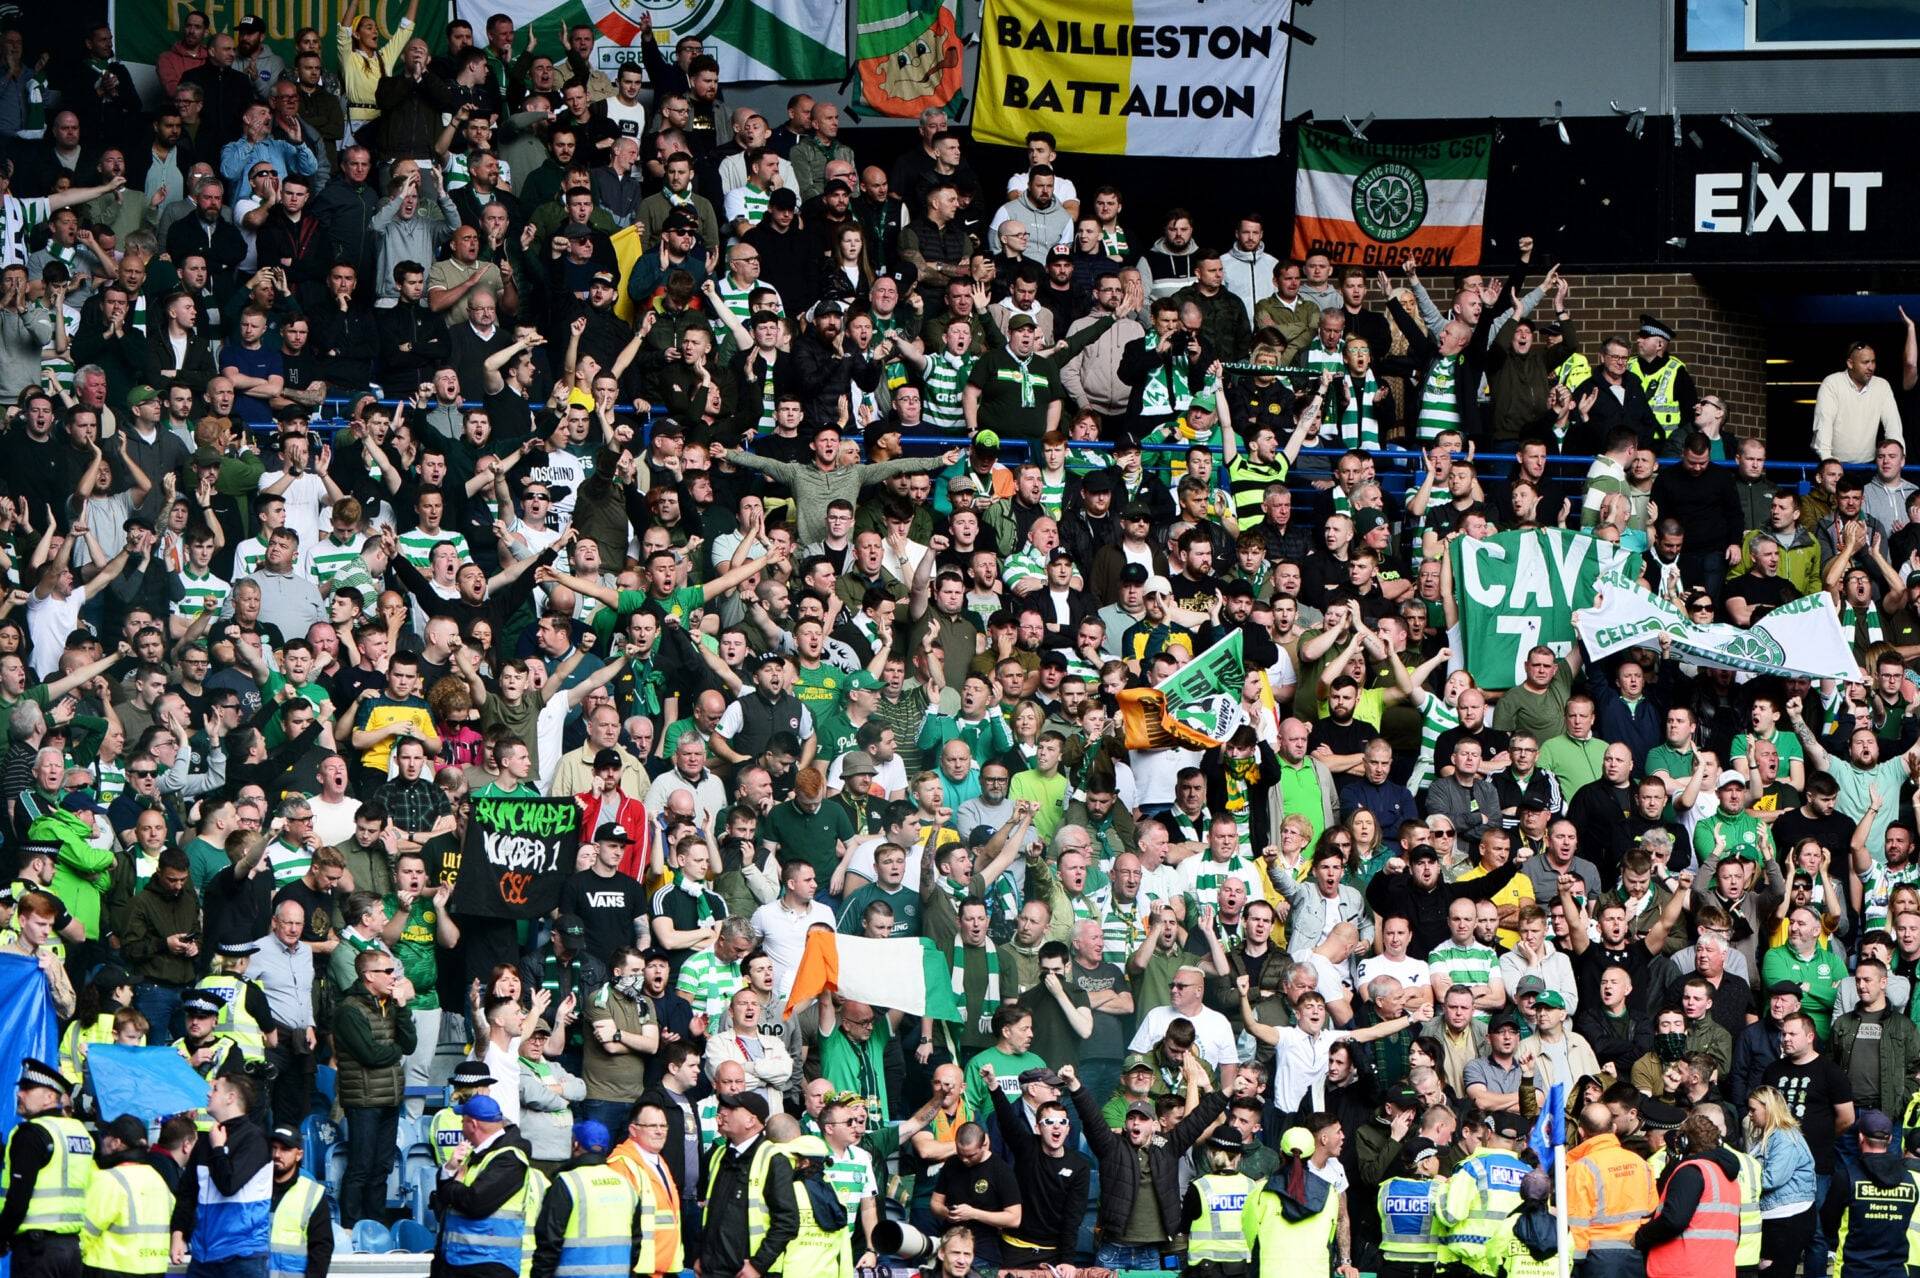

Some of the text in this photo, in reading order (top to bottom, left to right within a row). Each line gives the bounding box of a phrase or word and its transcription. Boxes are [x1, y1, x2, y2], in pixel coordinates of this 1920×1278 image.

[997, 15, 1272, 59] BAILLIESTON
[1003, 74, 1255, 119] BATTALION
[1358, 166, 1383, 190] CELTIC
[1385, 163, 1420, 189] FOOTBALL
[1412, 189, 1424, 213] CLUB
[1695, 172, 1882, 232] EXIT
[1377, 228, 1397, 239] 1888
[483, 831, 546, 873] NUMBER
[500, 872, 534, 905] CSC
[586, 892, 625, 908] VANS
[1493, 1169, 1523, 1184] POLIC
[1211, 1196, 1245, 1210] POLIC
[1861, 1185, 1911, 1198] SECURITY
[1387, 1199, 1428, 1213] POLICE
